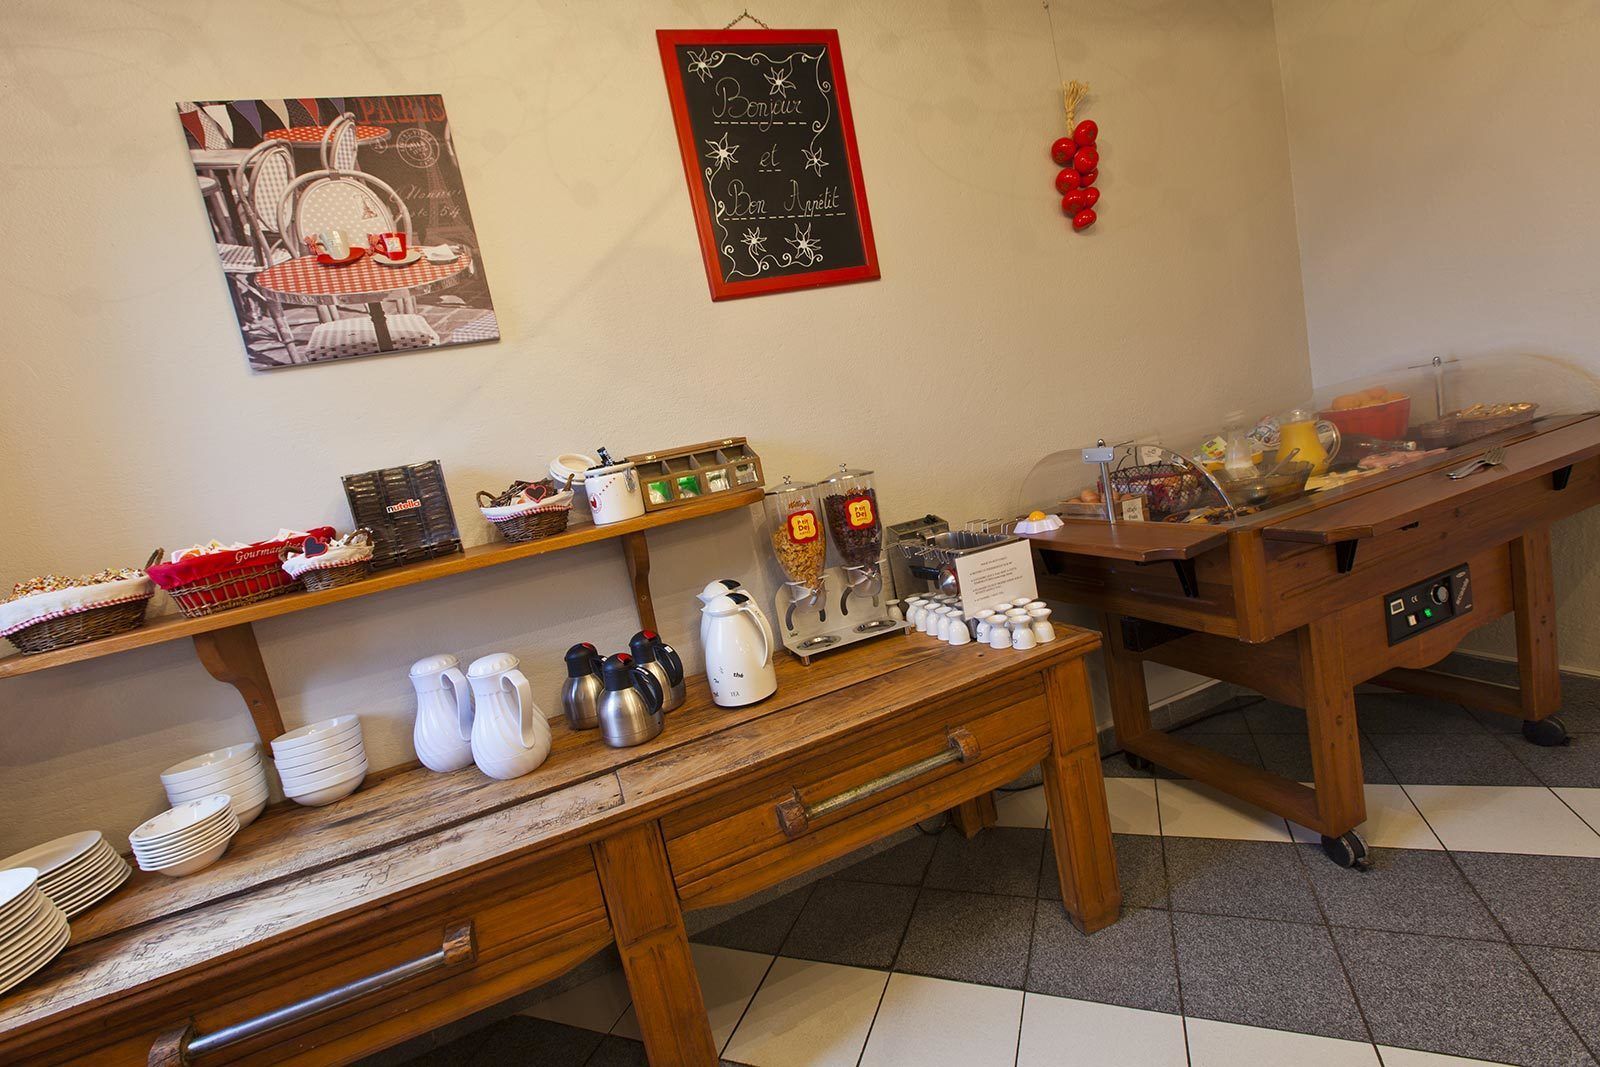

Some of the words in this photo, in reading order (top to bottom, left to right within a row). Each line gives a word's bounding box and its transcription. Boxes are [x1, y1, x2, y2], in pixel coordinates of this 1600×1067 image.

[359, 97, 445, 123] PARIS
[713, 77, 802, 132] Bonjour
[760, 143, 779, 167] et
[725, 178, 767, 217] Bon
[784, 179, 840, 217] Appétit
[387, 499, 421, 513] nutella
